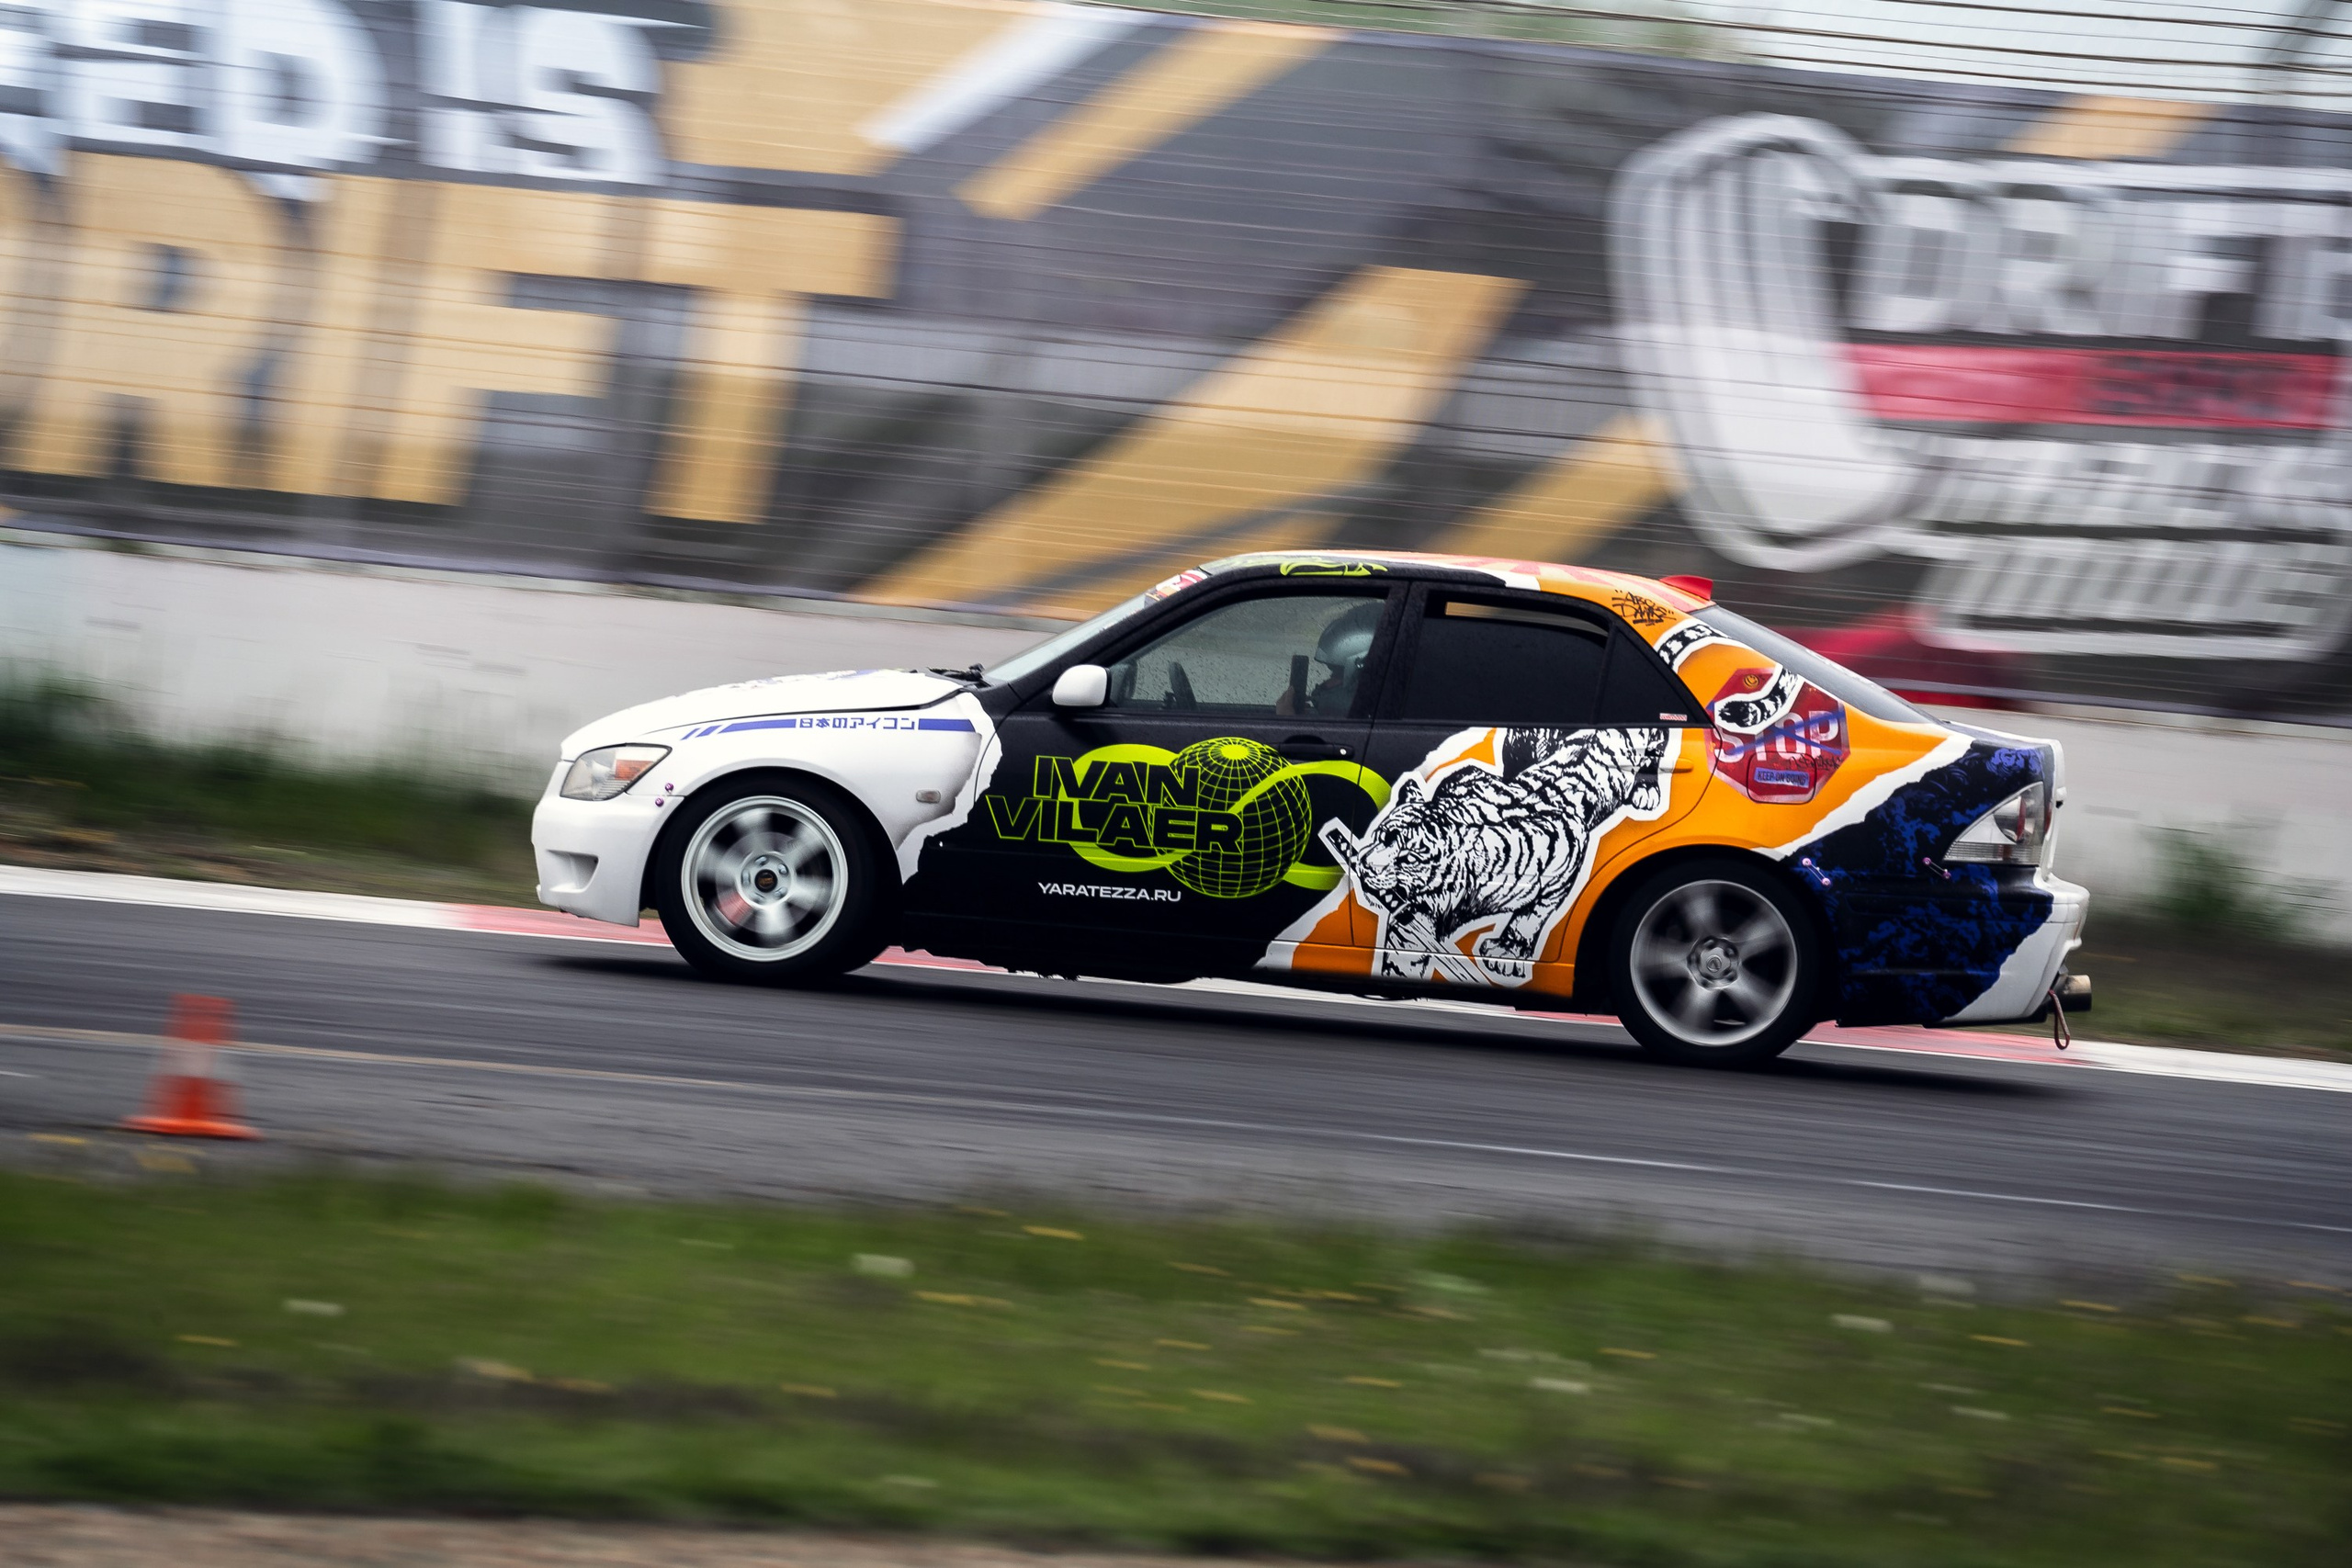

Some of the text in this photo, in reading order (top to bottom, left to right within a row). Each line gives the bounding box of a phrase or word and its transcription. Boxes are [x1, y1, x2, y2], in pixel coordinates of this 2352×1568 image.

[420, 0, 660, 185] IS
[799, 716, 915, 730] 日本のアイコン
[1713, 710, 1839, 763] STOP
[1033, 755, 1202, 808] IVAN
[1758, 770, 1774, 782] KEEP
[1776, 772, 1785, 783] ON
[985, 794, 1244, 854] VILAER
[1037, 881, 1182, 903] YARATEZZA.RU
